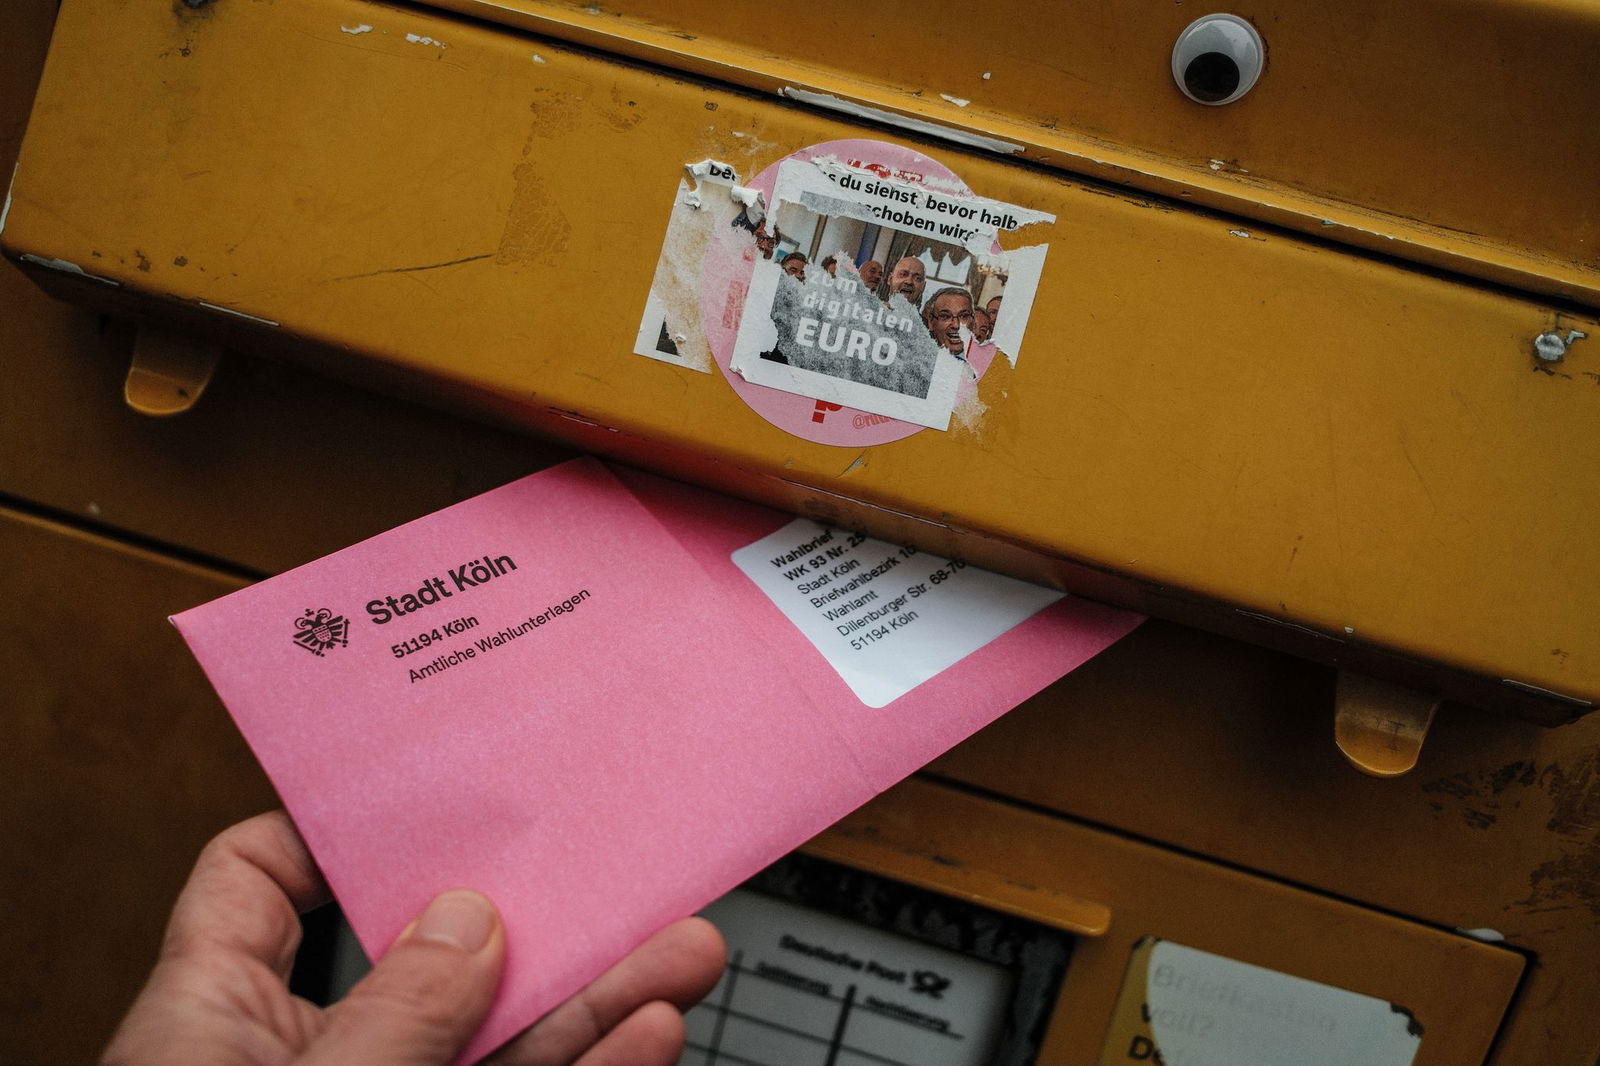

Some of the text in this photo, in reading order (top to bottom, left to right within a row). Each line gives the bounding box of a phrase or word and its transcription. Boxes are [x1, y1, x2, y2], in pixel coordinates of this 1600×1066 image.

[840, 174, 861, 190] du
[926, 195, 977, 220] bevor
[980, 209, 1018, 229] halb
[802, 292, 913, 333] digitalen
[796, 316, 898, 366] EURO
[770, 529, 834, 568] Wahlbrief
[783, 564, 810, 581] WK
[809, 555, 827, 569] 93
[825, 546, 849, 559] Nr.
[366, 555, 518, 624] Stadt Köln
[797, 558, 860, 595] Stadt Köln
[810, 556, 900, 609] Briefwahlbezirk
[822, 590, 879, 622] Wahlamt
[836, 593, 909, 637] Dillenburger
[907, 582, 933, 600] Str.
[391, 615, 479, 659] 51194 Köln
[408, 589, 591, 683] Amtliche Wahlunterlagen
[851, 609, 919, 651] 51194 Köln
